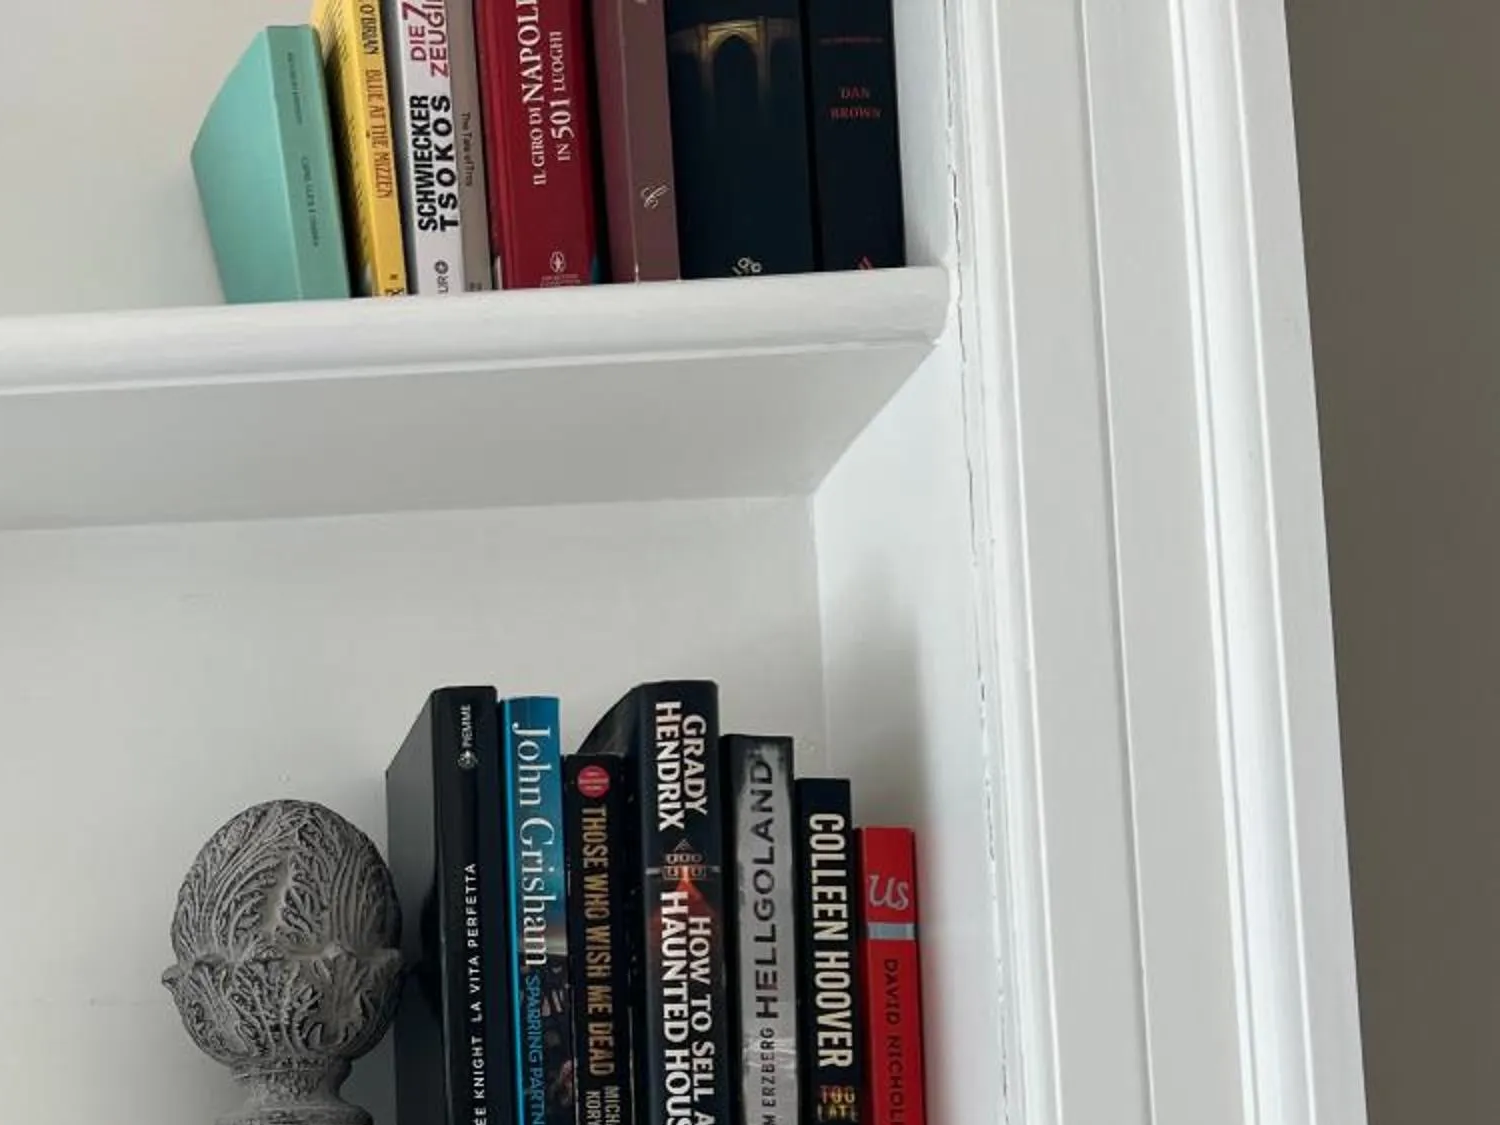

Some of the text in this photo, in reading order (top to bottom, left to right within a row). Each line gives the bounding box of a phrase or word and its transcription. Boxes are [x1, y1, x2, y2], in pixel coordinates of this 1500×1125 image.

[409, 25, 426, 61] DIE
[422, 0, 449, 77] ZEUGI
[460, 112, 471, 131] The
[528, 107, 544, 125] DI
[549, 31, 575, 161] IN 501 LUOGHI
[831, 106, 881, 119] BROWN
[841, 87, 871, 99] DAN
[365, 69, 393, 199] BLUE AT THE MIZZEN
[409, 94, 438, 232] SCHWIECKER
[431, 95, 459, 232] TSOKOS
[529, 129, 546, 165] GIRO
[533, 173, 547, 185] IL
[655, 701, 685, 832] HENDRIX
[682, 714, 708, 816] GRADY
[512, 721, 557, 966] John Grisham
[582, 806, 609, 869] THOSE
[465, 863, 479, 948] PERFETTA
[584, 874, 611, 921] WHO
[749, 759, 779, 1020] HELLGOLAND
[868, 873, 910, 911] Us
[585, 925, 612, 978] WISH
[660, 891, 690, 1044] HAUNTED
[688, 916, 711, 985] HOW
[809, 812, 853, 1069] COLLEEN HOOVER
[468, 955, 481, 994] VITA
[587, 985, 613, 1015] ME
[884, 959, 900, 1026] DAVID
[470, 1002, 483, 1023] LA
[525, 974, 543, 1064] SPARRING
[691, 994, 713, 1032] TO
[471, 1035, 486, 1099] KNIGHT
[588, 1022, 615, 1076] DEAD
[692, 1040, 715, 1102] SELL
[760, 1027, 777, 1108] ERZBERG
[820, 1085, 856, 1104] TOO
